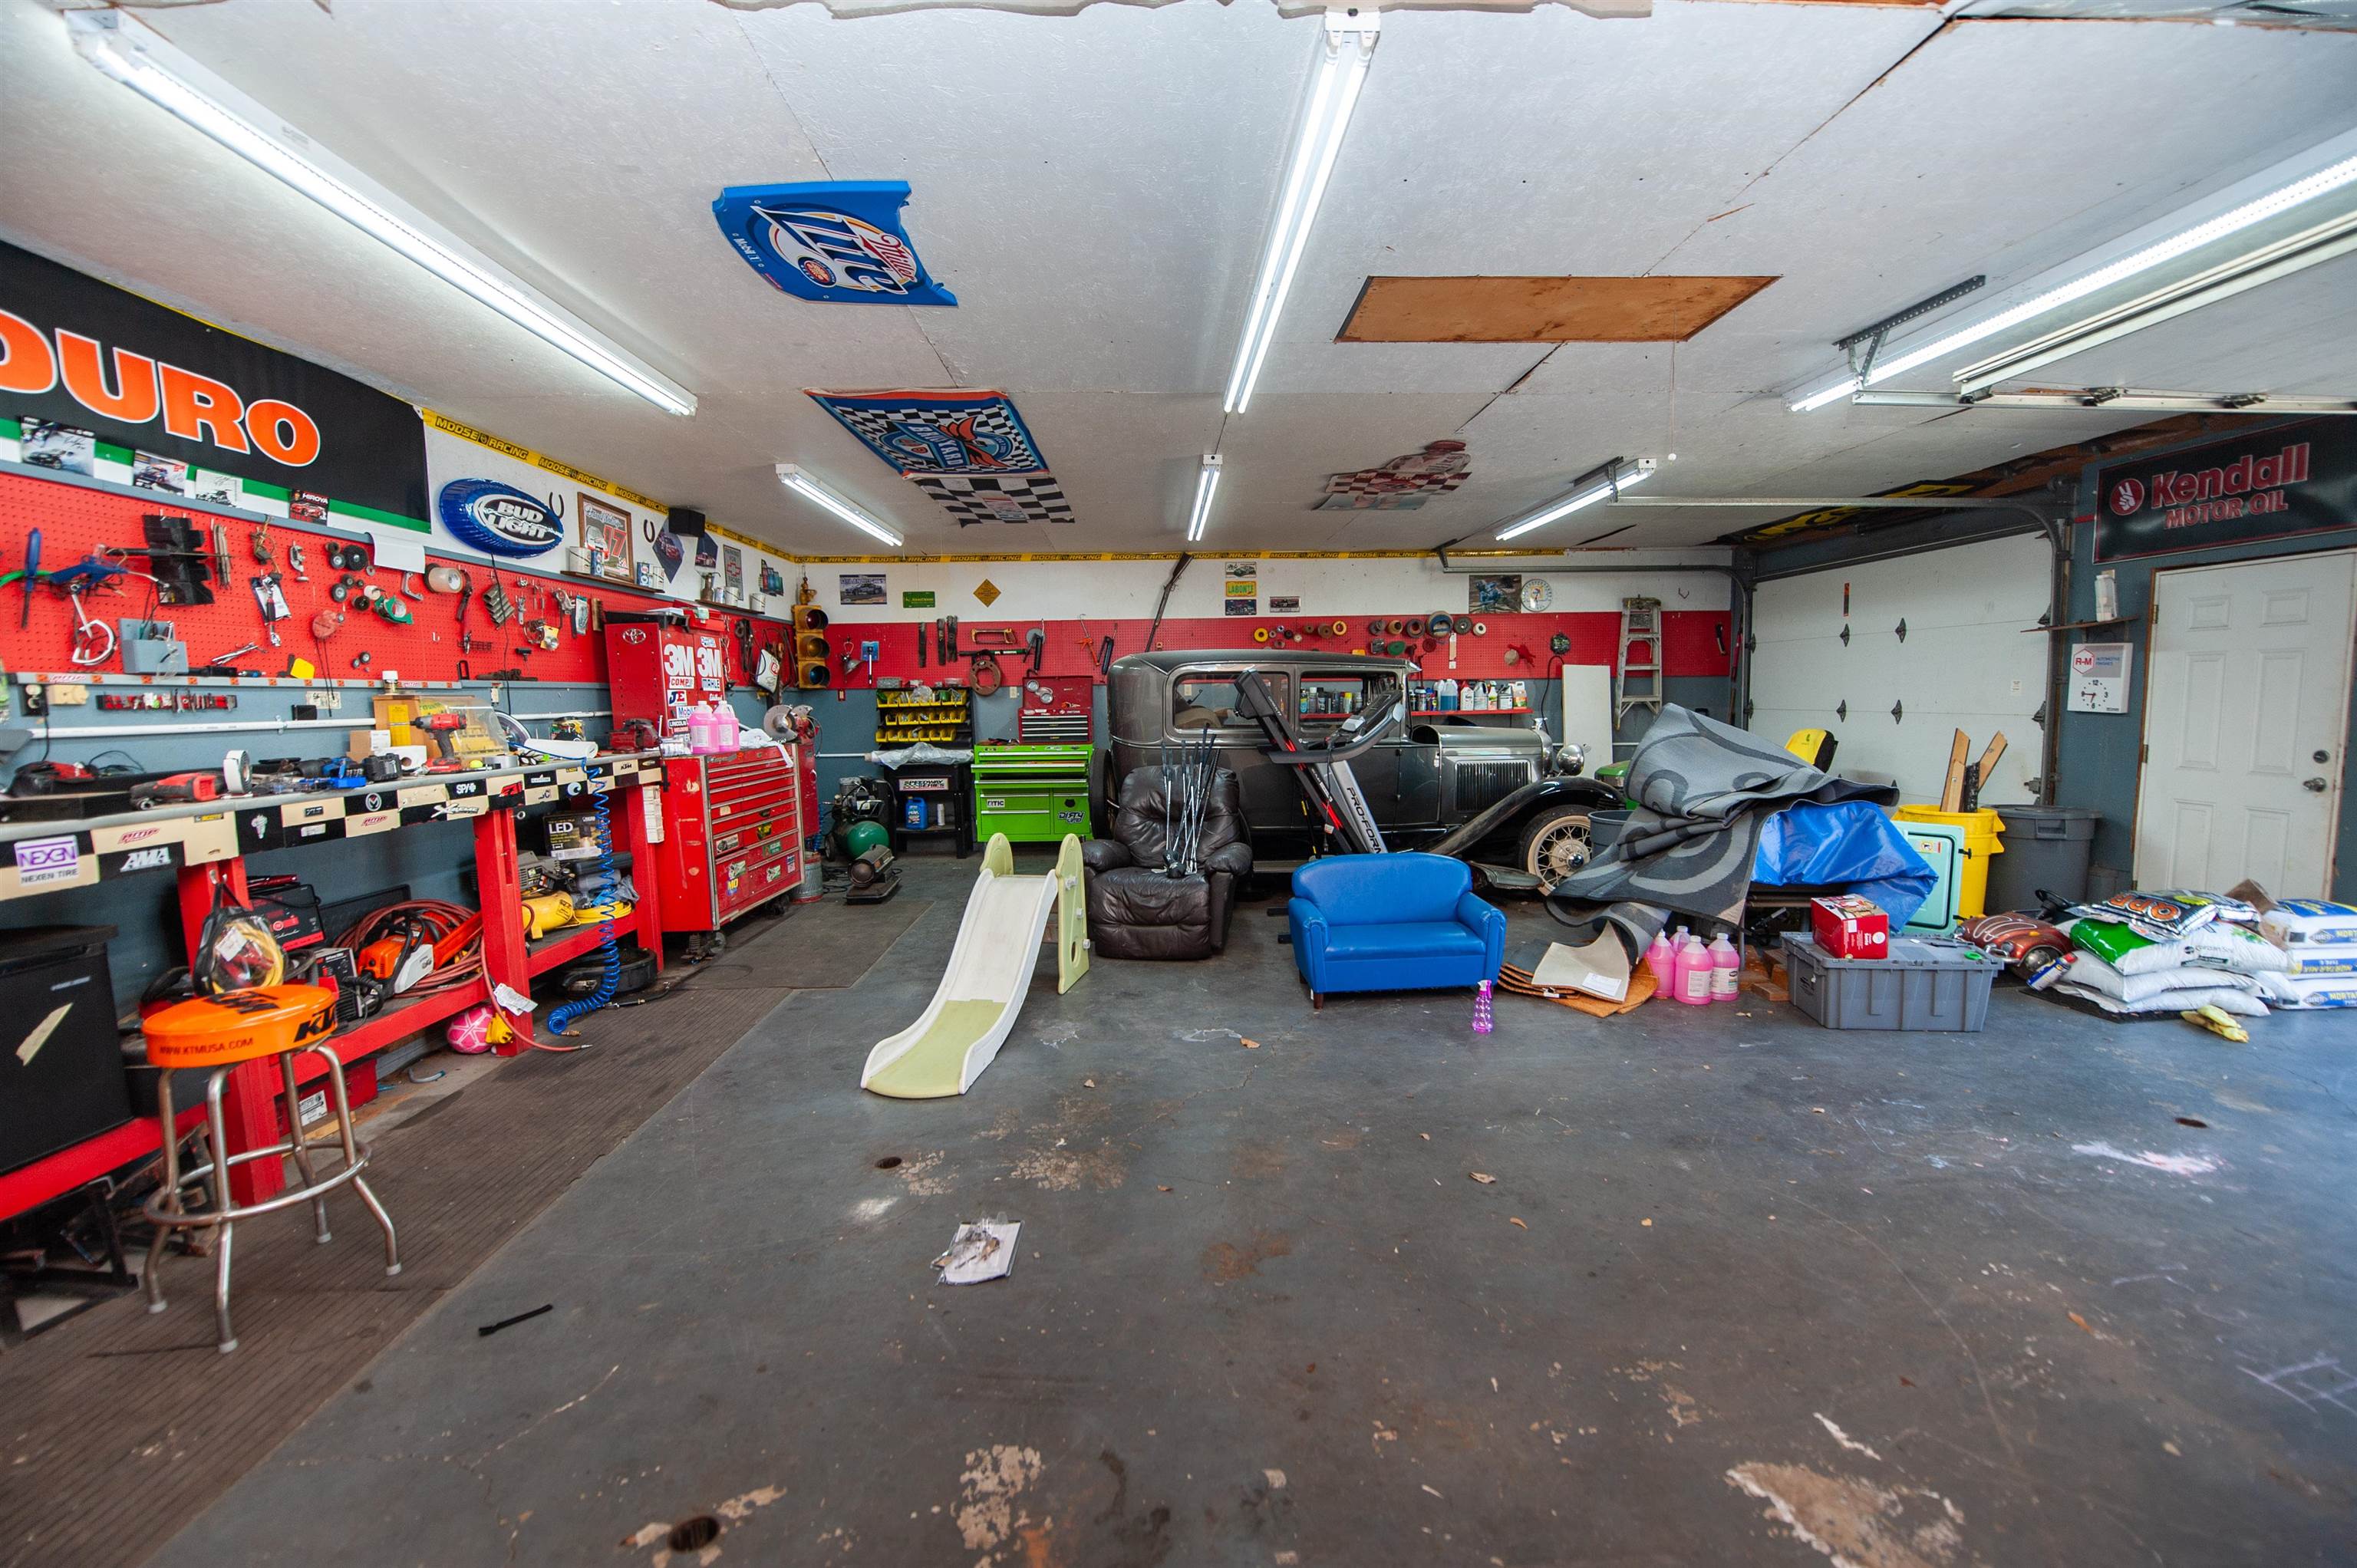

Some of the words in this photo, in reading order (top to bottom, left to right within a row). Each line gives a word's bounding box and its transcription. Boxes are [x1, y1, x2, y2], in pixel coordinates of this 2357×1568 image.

[733, 238, 753, 261] Mobil
[436, 417, 480, 440] MOOSE
[488, 437, 529, 460] RACING
[539, 457, 571, 476] MOOSE
[576, 473, 608, 491] RACING
[2151, 443, 2309, 509] Kendall
[302, 492, 329, 505] HIROYA
[2165, 497, 2243, 529] MOTOR
[2249, 490, 2289, 516] OIL
[497, 500, 544, 523] BUD
[487, 514, 548, 539] LIGHT
[664, 643, 696, 677] 3M
[697, 647, 722, 677] 3M
[2075, 657, 2092, 666] R-M
[669, 690, 685, 705] JE
[549, 822, 574, 835] LED
[18, 846, 76, 867] NEXEN
[120, 847, 172, 872] AMA
[21, 871, 54, 883] NEXEN
[58, 869, 78, 878] TIRE
[294, 1003, 336, 1043] KT
[159, 1038, 254, 1056] WWW.KTMUSA.COM
